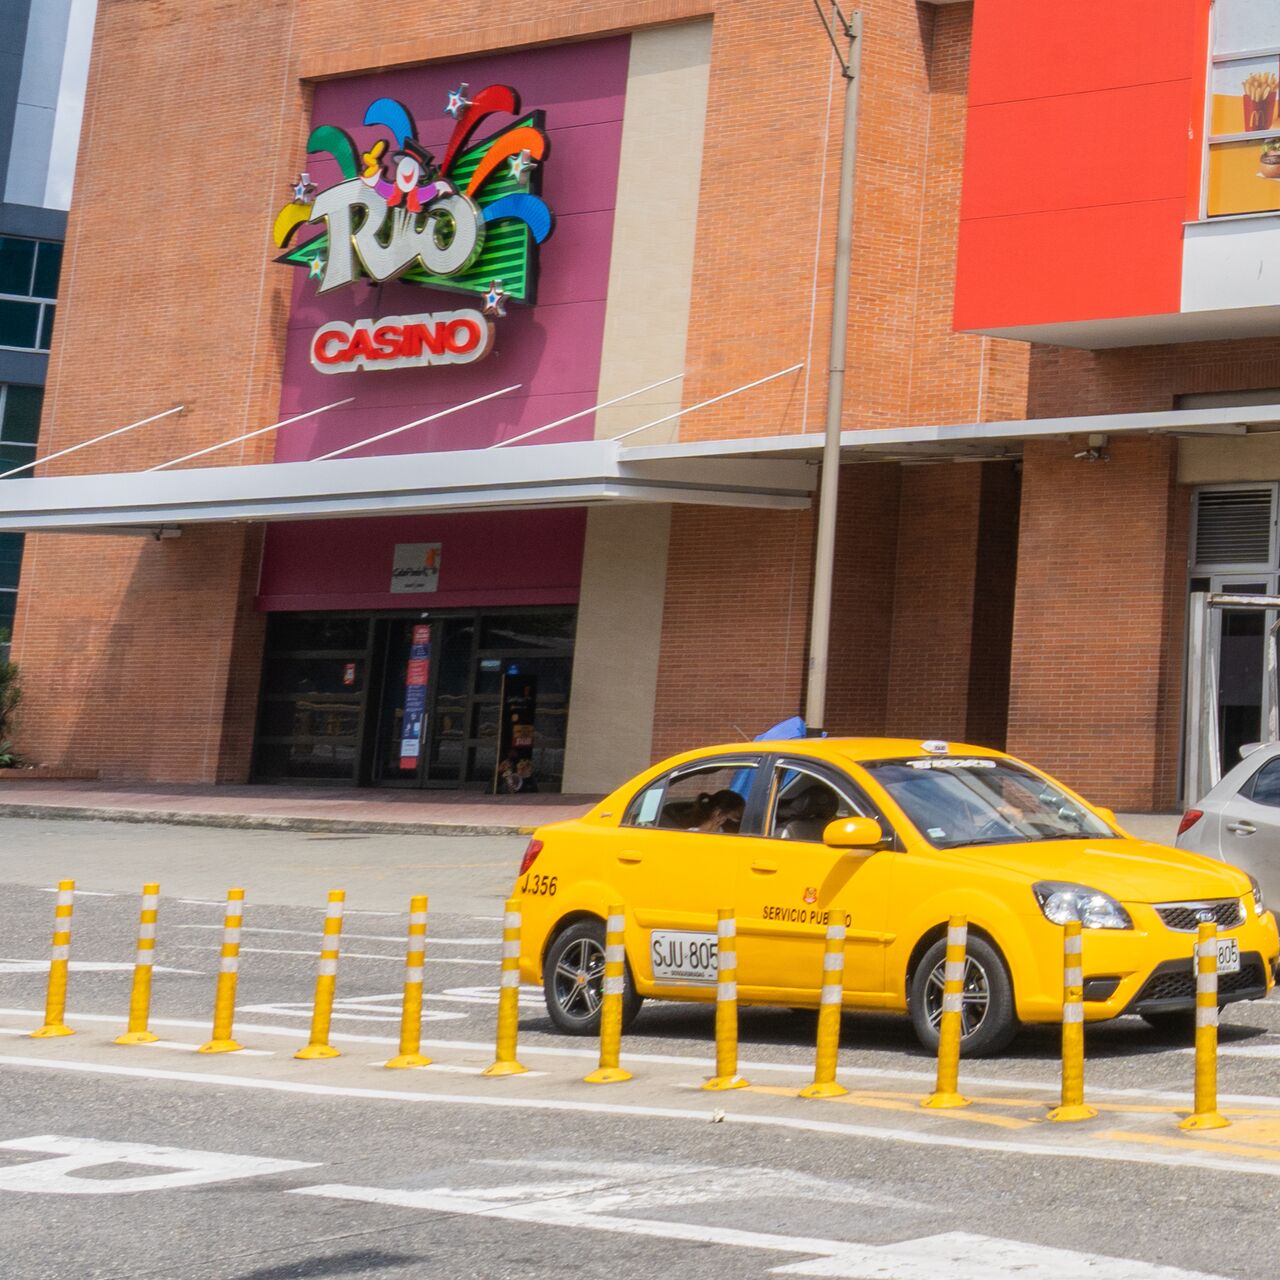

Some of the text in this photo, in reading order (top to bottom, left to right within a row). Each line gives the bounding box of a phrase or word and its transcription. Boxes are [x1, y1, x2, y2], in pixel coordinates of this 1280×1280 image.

[314, 318, 482, 365] CASINO
[762, 905, 852, 928] SERVICIO PUBO
